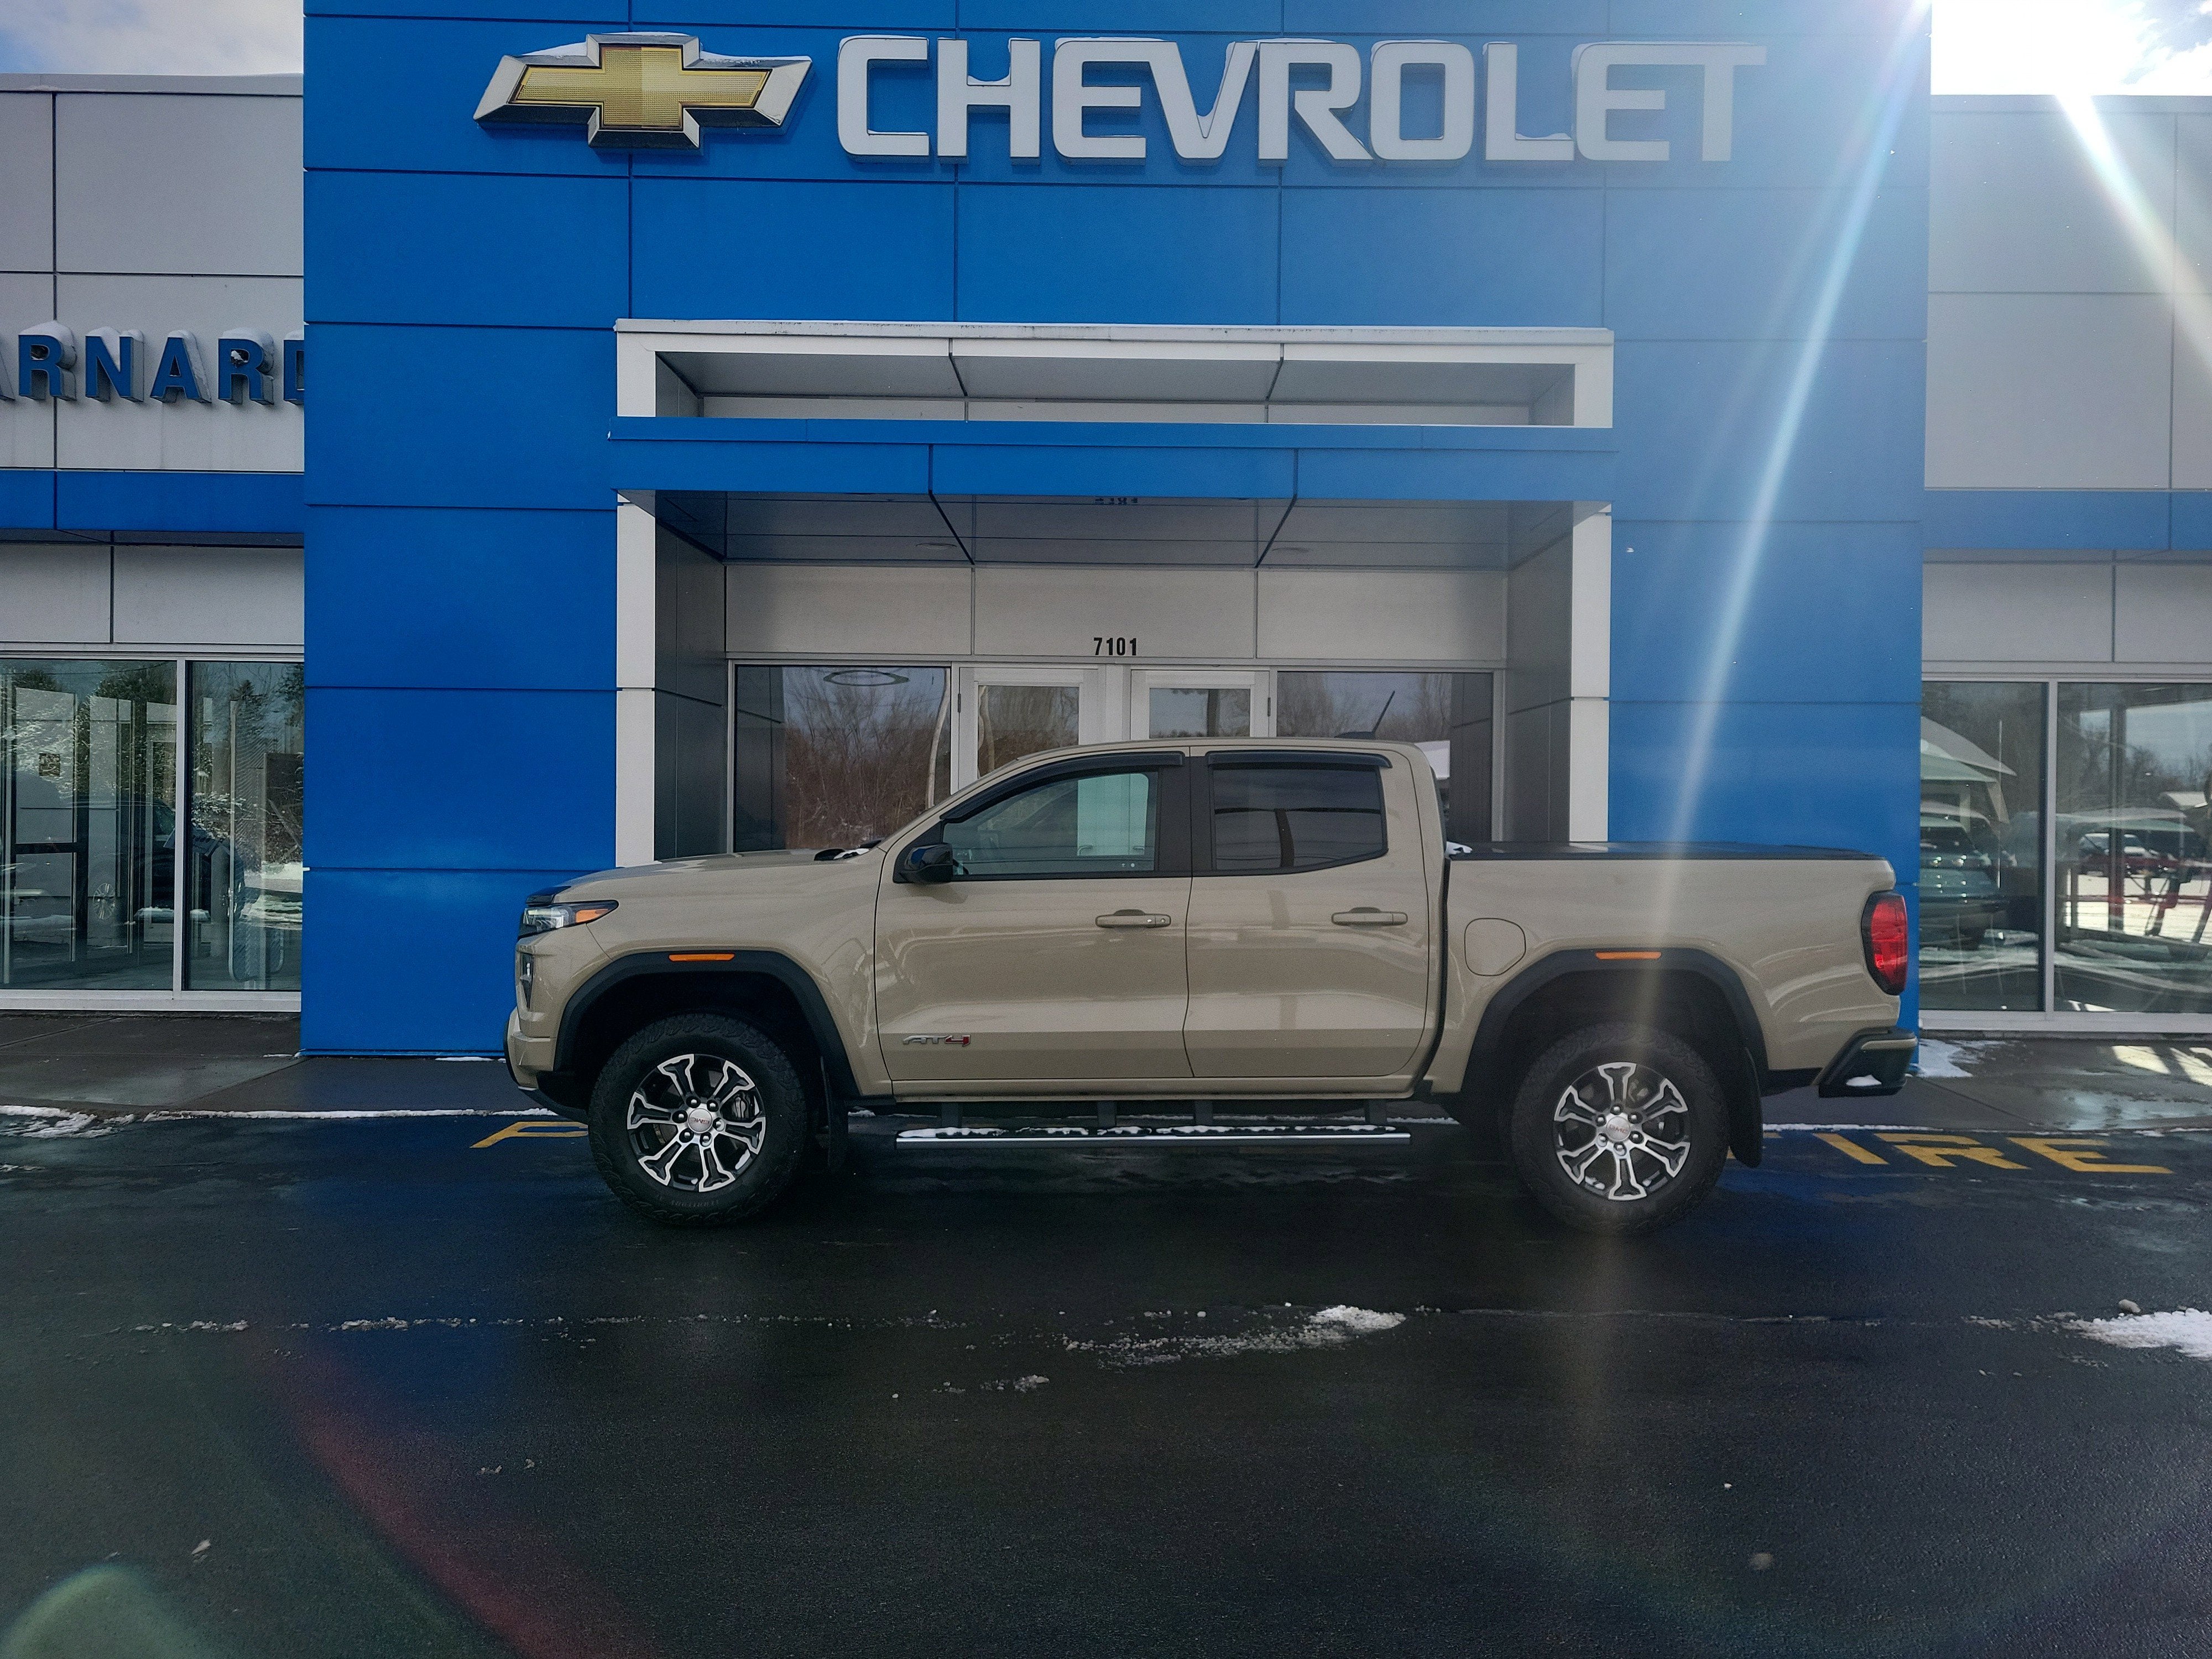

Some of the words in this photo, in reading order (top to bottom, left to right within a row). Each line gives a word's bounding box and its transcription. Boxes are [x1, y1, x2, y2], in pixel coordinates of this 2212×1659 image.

[837, 35, 1767, 162] CHEVROLET
[0, 333, 304, 404] RNAR
[1093, 637, 1138, 656] 7101
[902, 1035, 971, 1047] AT4
[1726, 1131, 2174, 1173] IRE
